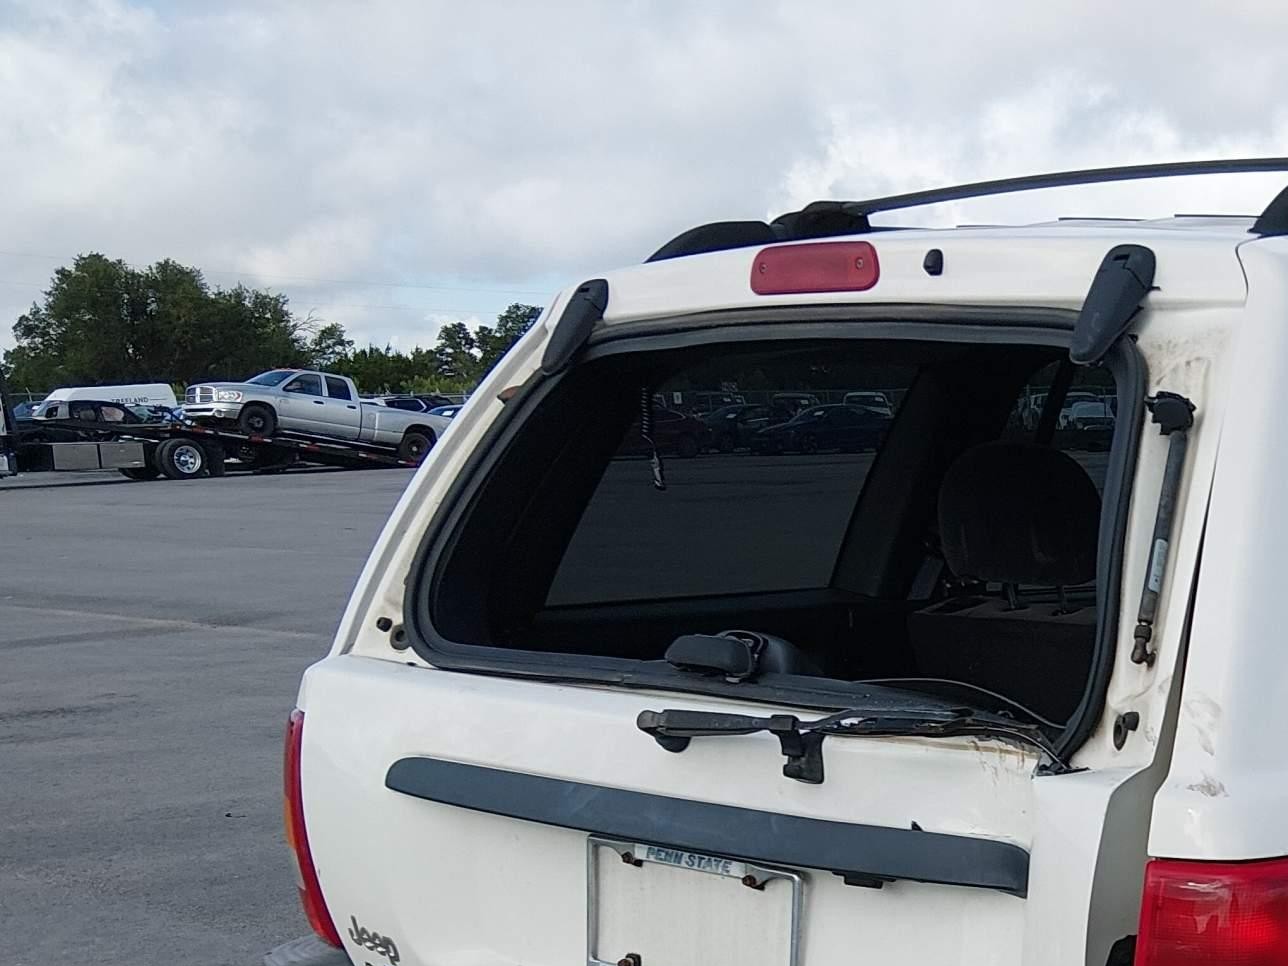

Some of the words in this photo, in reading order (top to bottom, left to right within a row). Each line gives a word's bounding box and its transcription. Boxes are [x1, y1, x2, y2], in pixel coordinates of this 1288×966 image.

[646, 846, 684, 865] PENN
[685, 853, 733, 874] STATE
[347, 914, 400, 966] Jeep
